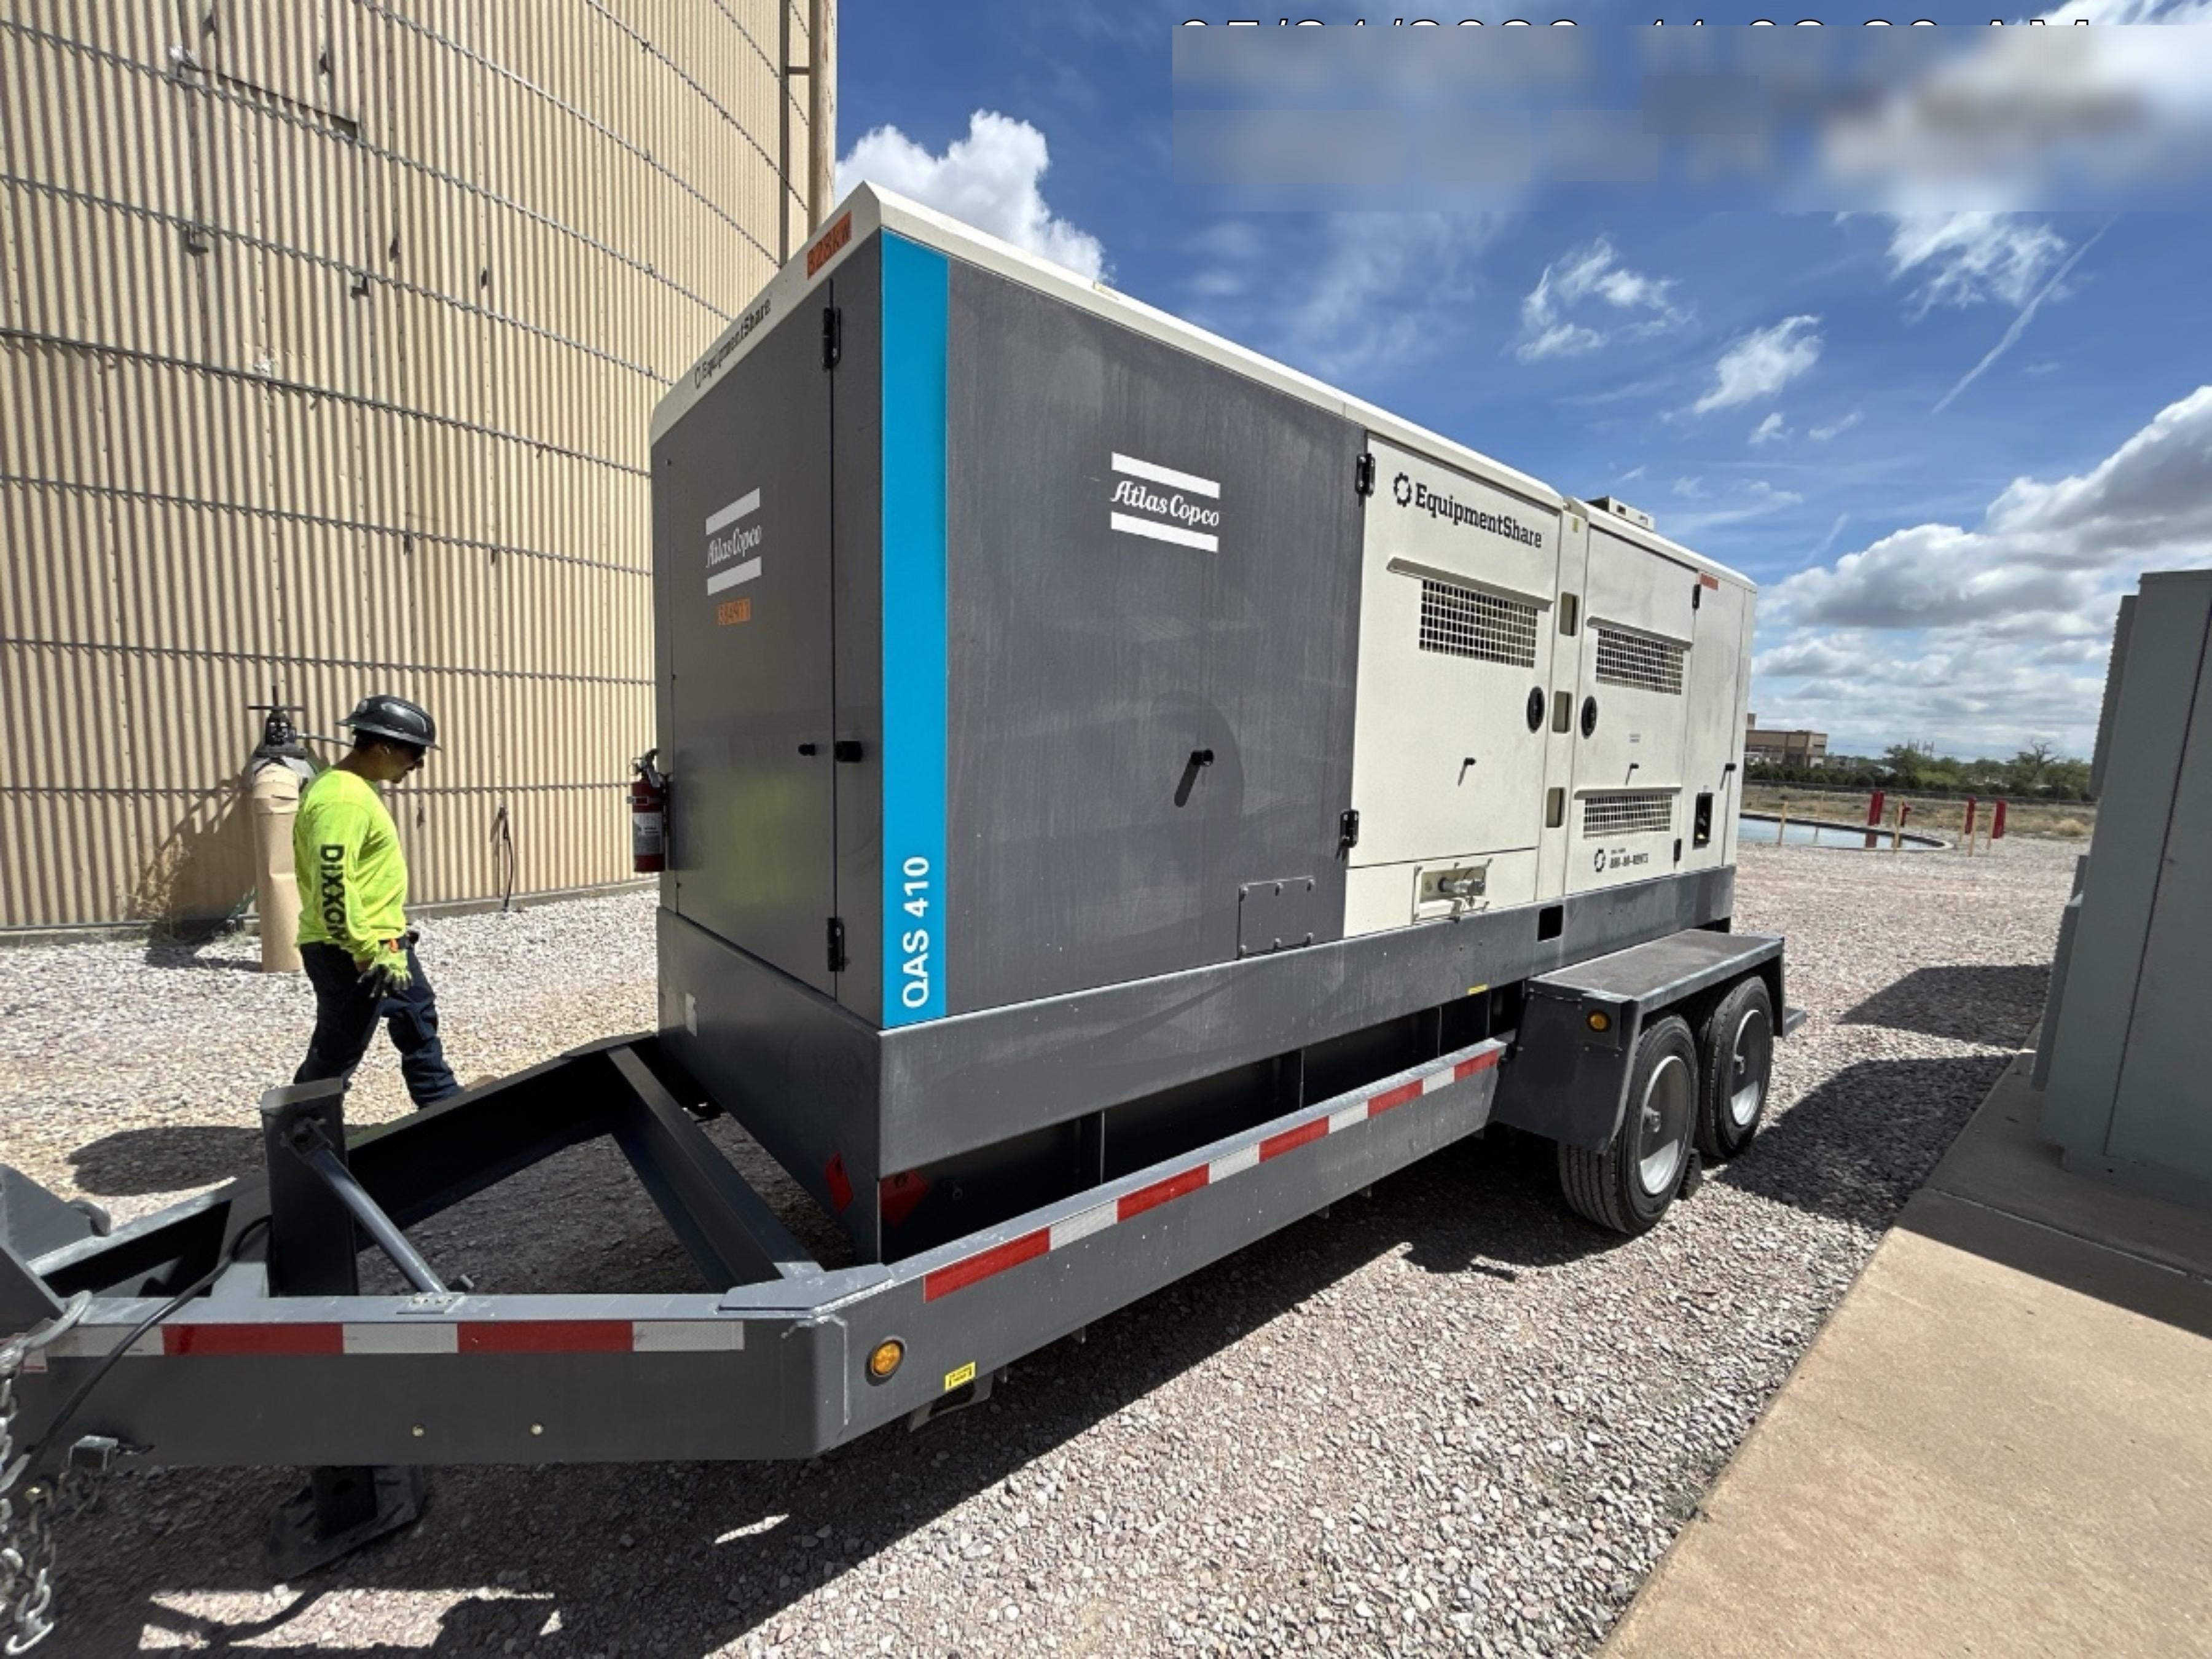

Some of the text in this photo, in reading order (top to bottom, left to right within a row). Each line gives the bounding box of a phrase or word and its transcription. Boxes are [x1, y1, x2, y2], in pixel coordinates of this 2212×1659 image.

[702, 299, 771, 380] EquipmentShare
[1110, 480, 1219, 527] Atlas Copco
[1415, 482, 1542, 548] EquipmentShare
[705, 525, 761, 568] Atlas Copco
[321, 844, 350, 940] DIXXON
[902, 856, 930, 1008] QAS 410
